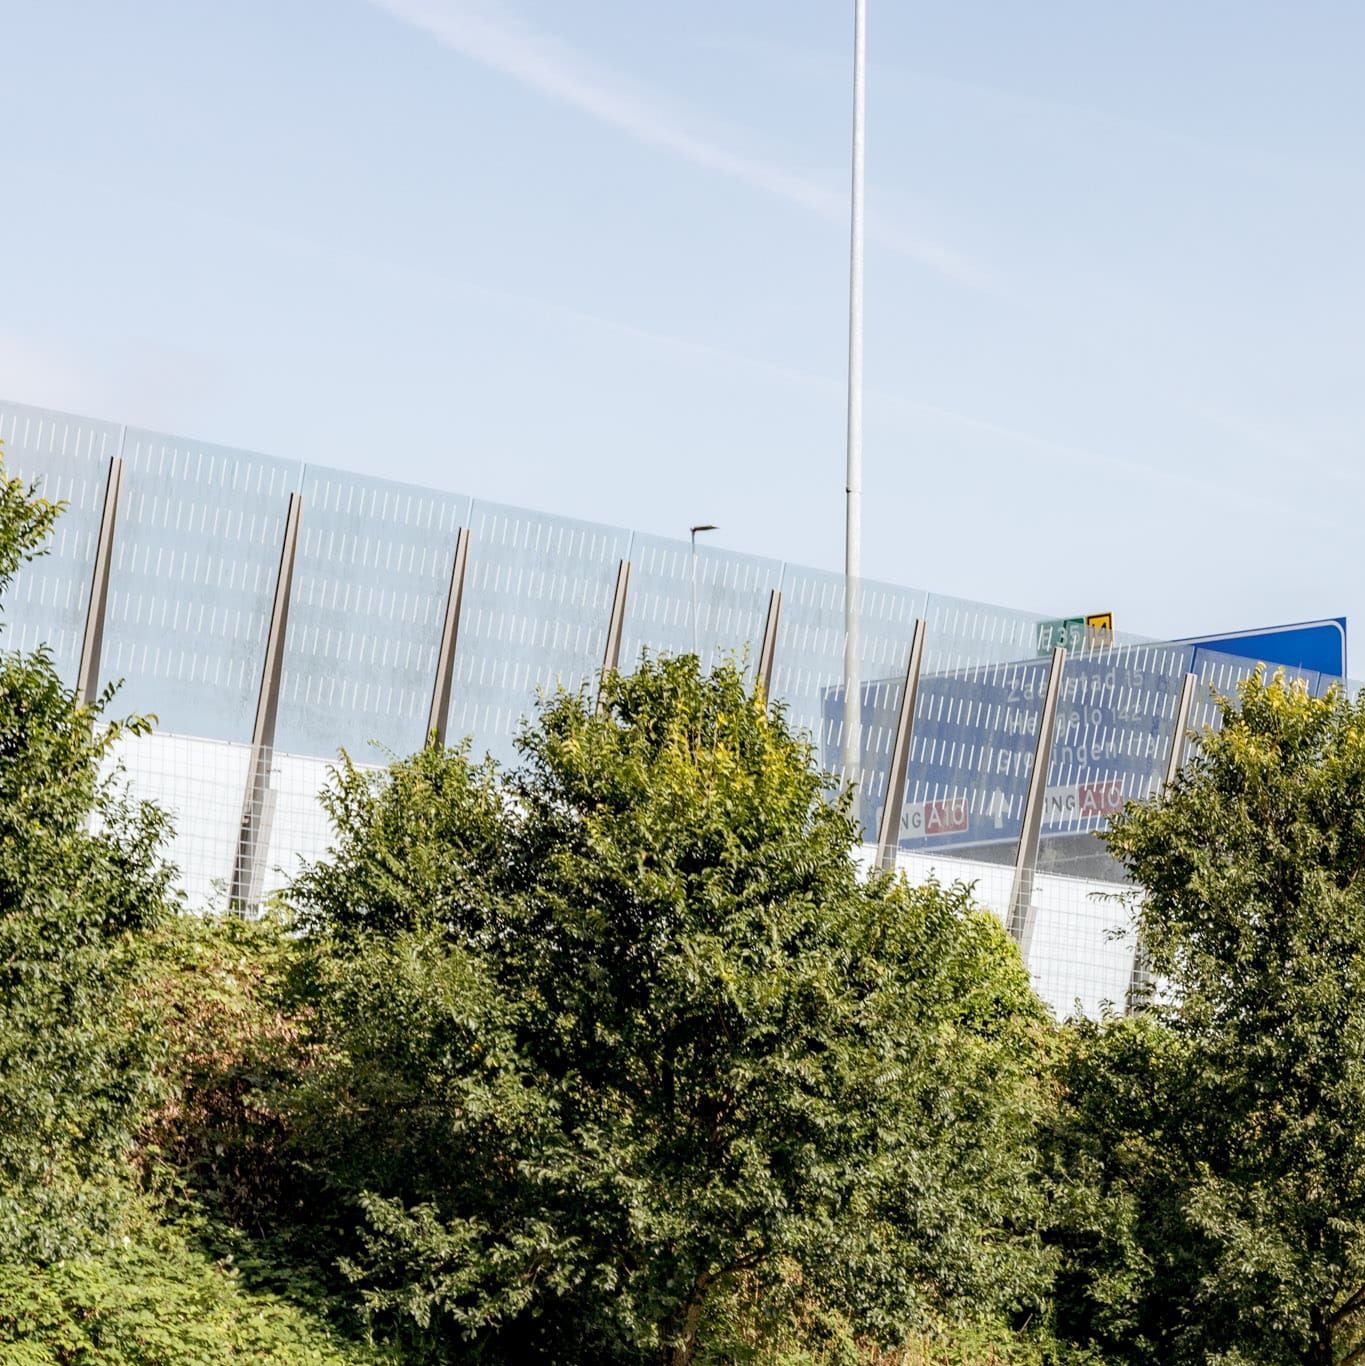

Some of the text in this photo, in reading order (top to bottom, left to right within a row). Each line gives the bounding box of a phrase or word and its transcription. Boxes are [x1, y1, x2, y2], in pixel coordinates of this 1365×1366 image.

[1056, 625, 1081, 647] 35
[1008, 704, 1142, 737] Hegelo 142
[997, 742, 1117, 771] Groingen
[1083, 786, 1120, 811] A10
[928, 803, 965, 829] A10
